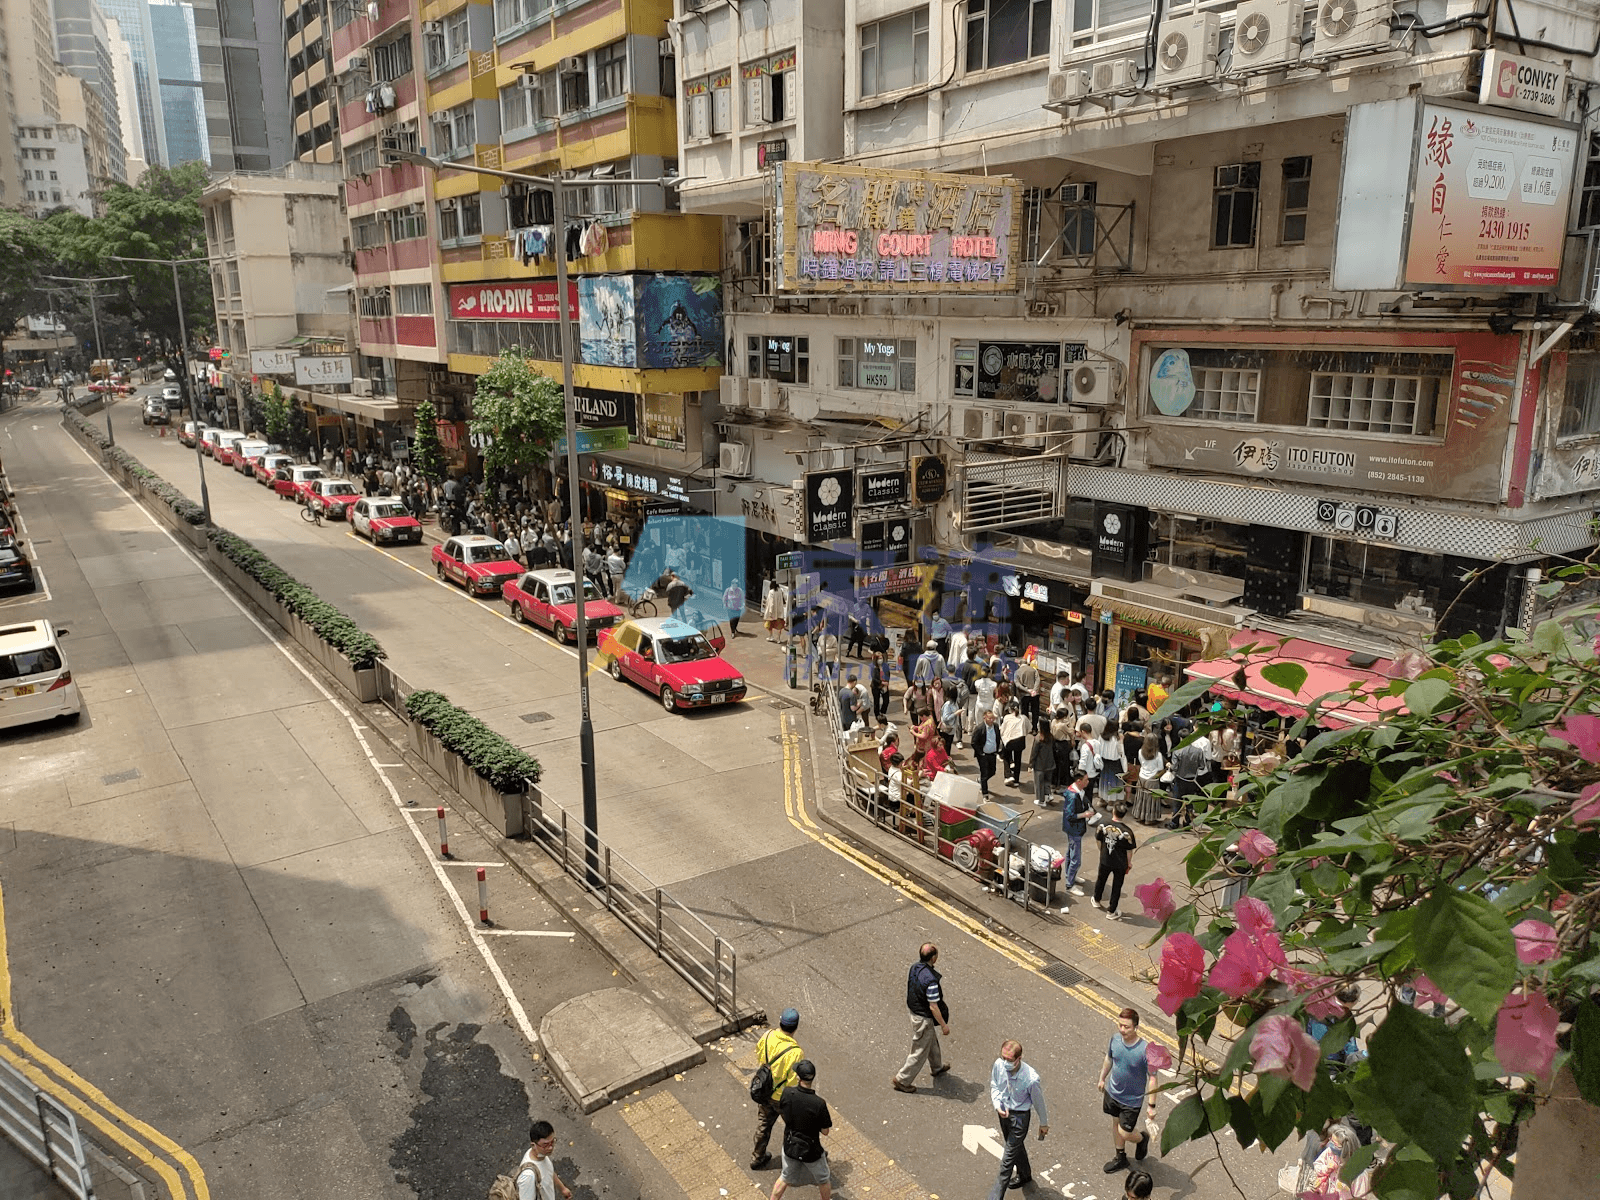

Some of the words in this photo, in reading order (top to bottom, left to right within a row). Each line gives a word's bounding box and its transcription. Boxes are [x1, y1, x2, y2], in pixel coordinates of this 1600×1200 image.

[1517, 65, 1559, 91] CONVEY
[1478, 219, 1504, 240] 2430
[1506, 222, 1531, 241] 1915
[813, 230, 857, 254] MING
[877, 233, 933, 257] COURT
[951, 236, 998, 258] HOTEL
[480, 288, 533, 313] PRO-DIVE
[768, 340, 778, 352] My
[863, 342, 875, 356] My
[877, 343, 895, 356] Yoga
[866, 374, 888, 386] HK$90
[1016, 372, 1039, 386] Gifts
[1204, 439, 1217, 449] 1/F
[1288, 448, 1308, 465] ITO
[1312, 450, 1355, 468] FUTON
[1369, 454, 1434, 467] www.itofuton.com
[1287, 462, 1328, 473] Japanese
[1332, 466, 1355, 476] Shop
[868, 477, 900, 489] Modern
[1367, 470, 1386, 481] (852)
[1387, 473, 1425, 484] 2845-1138
[868, 487, 900, 497] Classic
[812, 510, 847, 524] Modern
[813, 520, 847, 532] Classic
[888, 543, 908, 551] Modern
[1098, 543, 1124, 553] Classic
[1099, 535, 1124, 548] Modern
